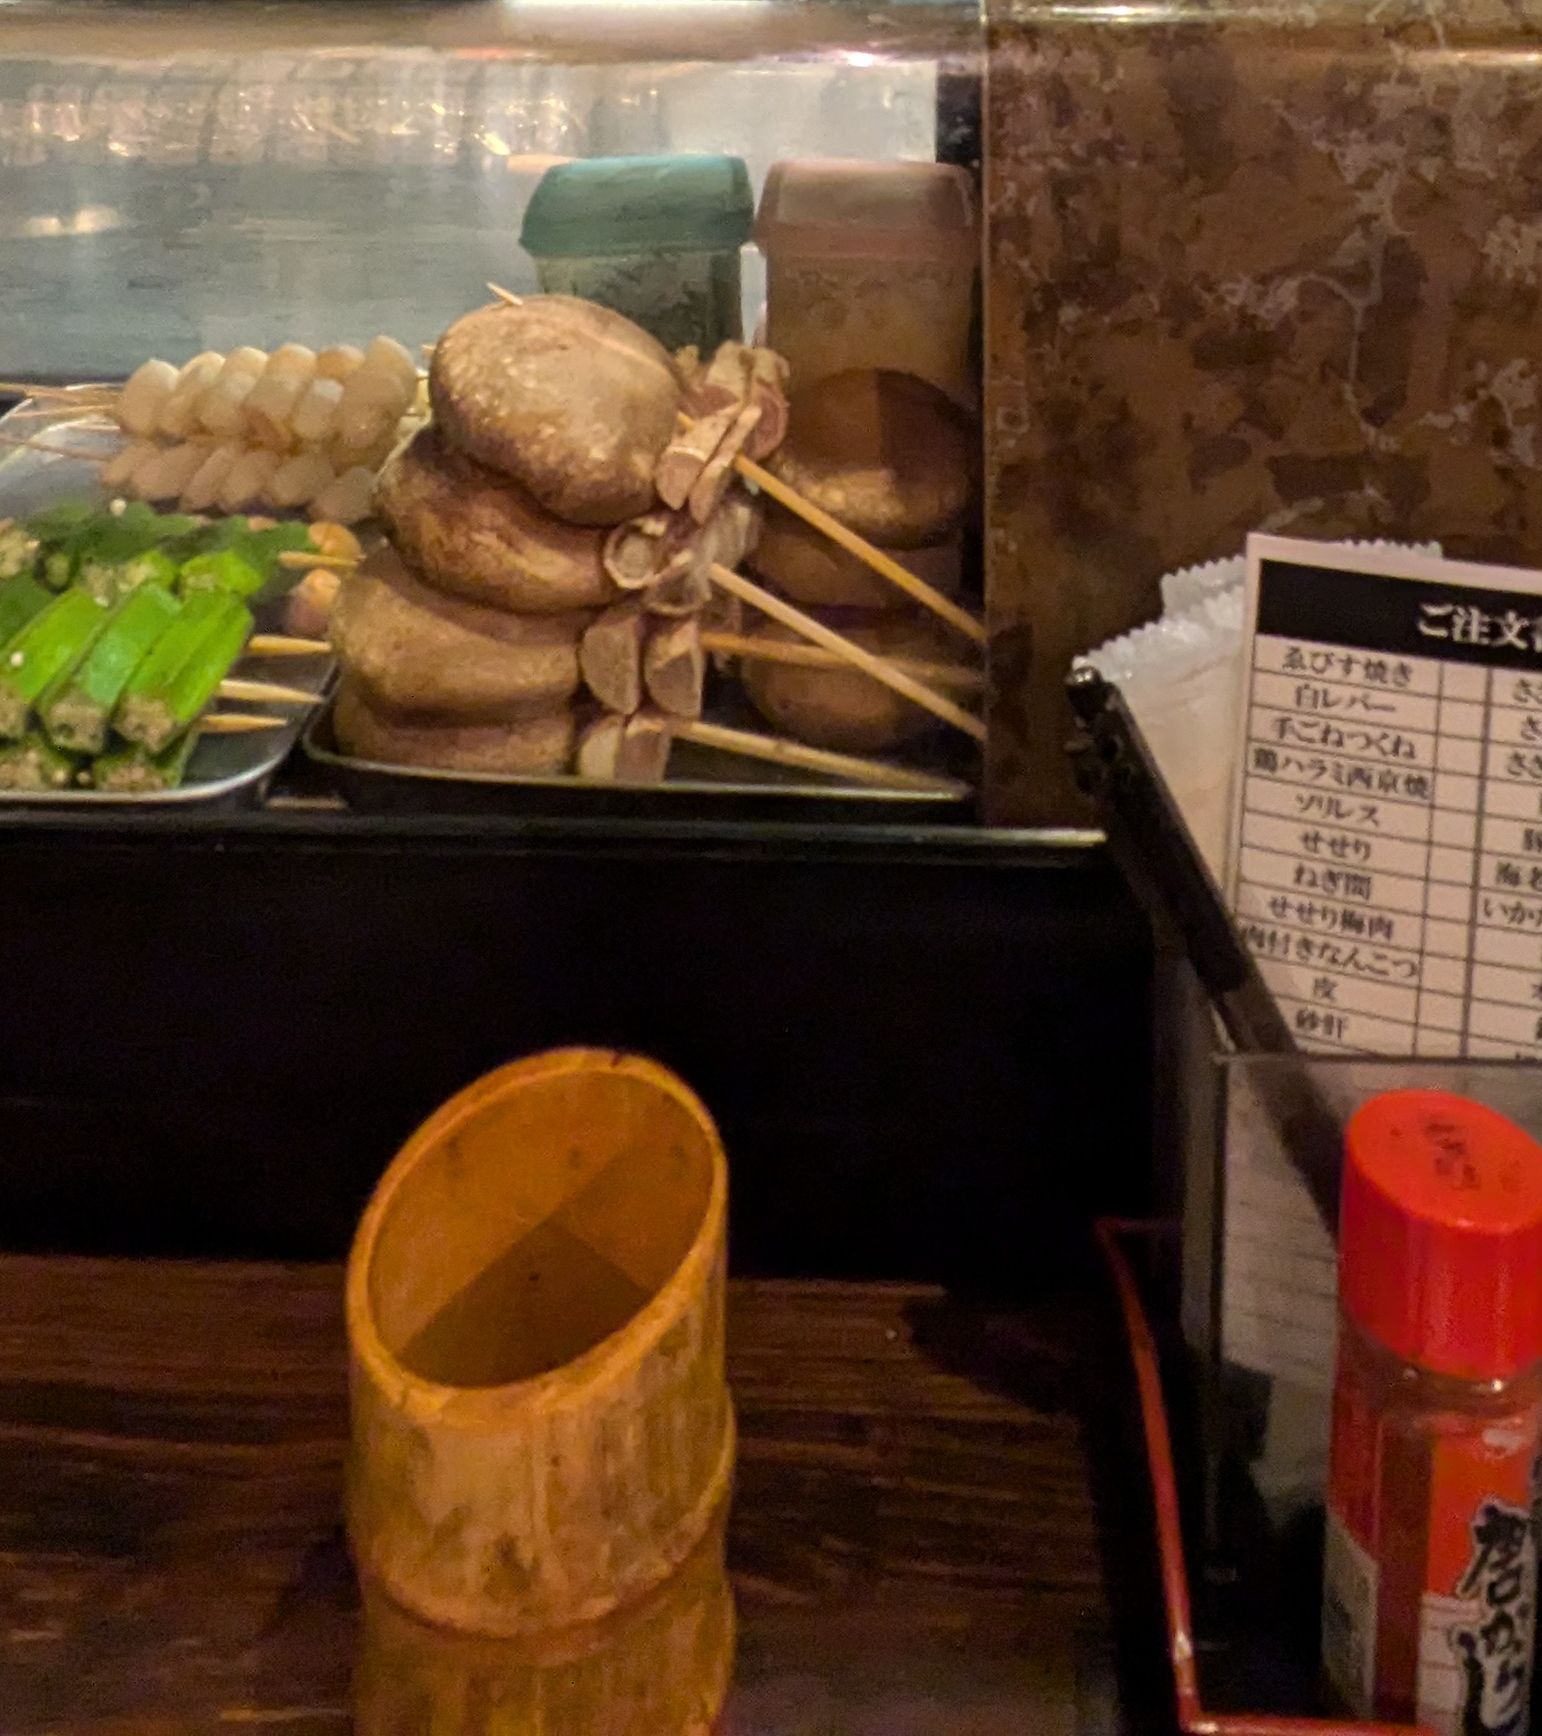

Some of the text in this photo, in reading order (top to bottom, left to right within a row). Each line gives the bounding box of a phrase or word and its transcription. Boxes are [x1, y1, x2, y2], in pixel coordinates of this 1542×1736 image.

[1295, 683, 1396, 711] 白レバー
[1273, 716, 1416, 760] 手ごねつくね
[1300, 830, 1372, 861] せせり
[1268, 896, 1394, 941] せせり梅肉
[1312, 976, 1338, 1002] 皮
